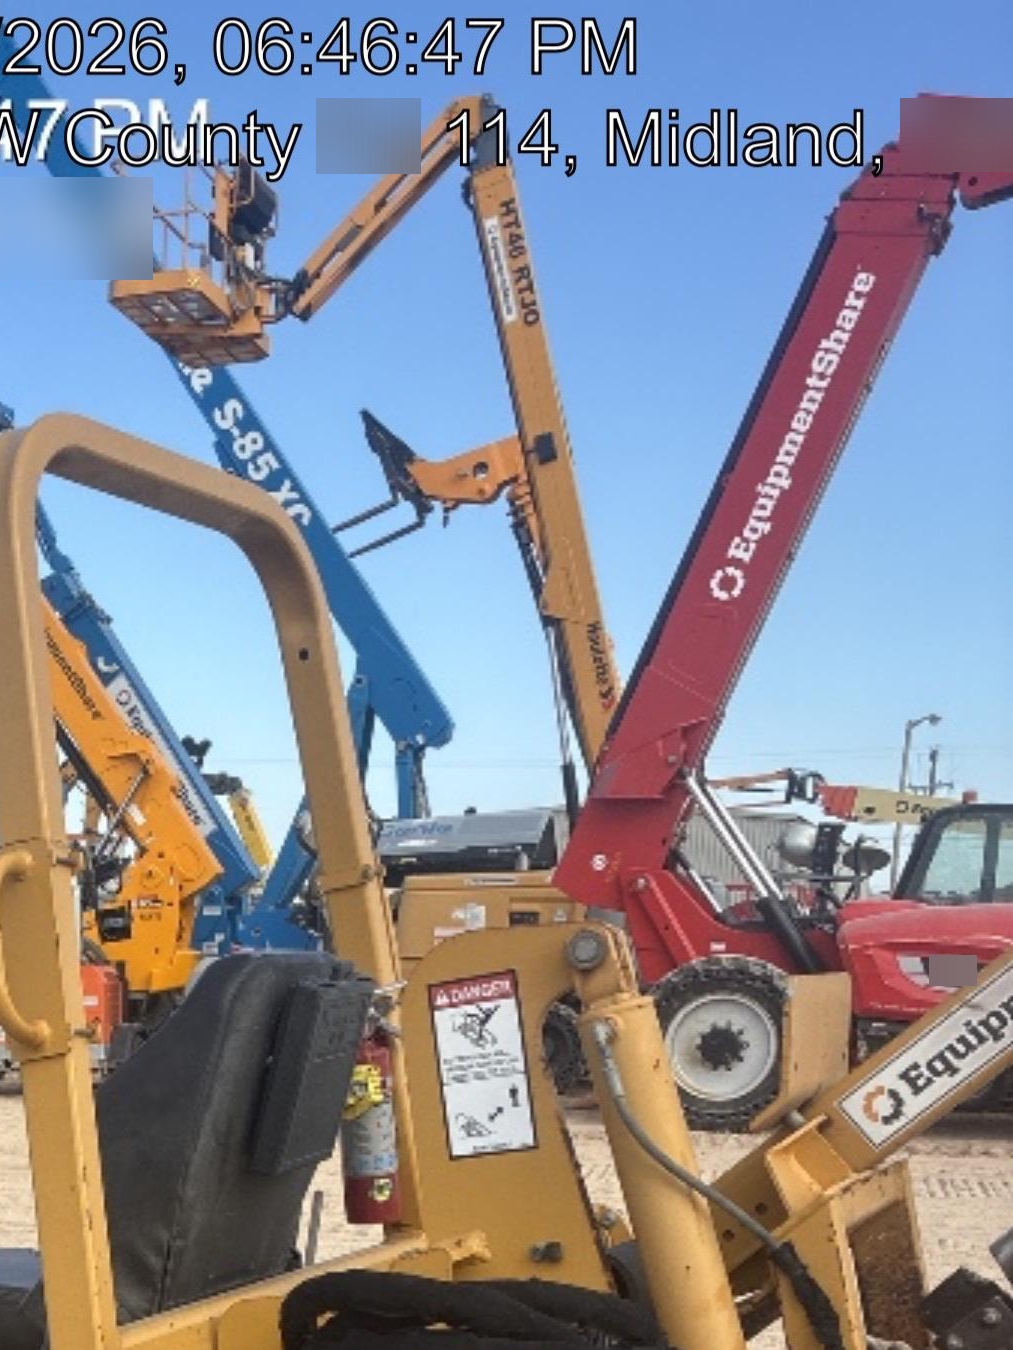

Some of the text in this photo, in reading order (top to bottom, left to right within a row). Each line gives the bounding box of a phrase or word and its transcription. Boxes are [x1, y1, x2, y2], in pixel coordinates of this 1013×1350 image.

[213, 398, 284, 482] S-85
[727, 269, 877, 564] EquipmentShare
[451, 979, 511, 1003] DANGER
